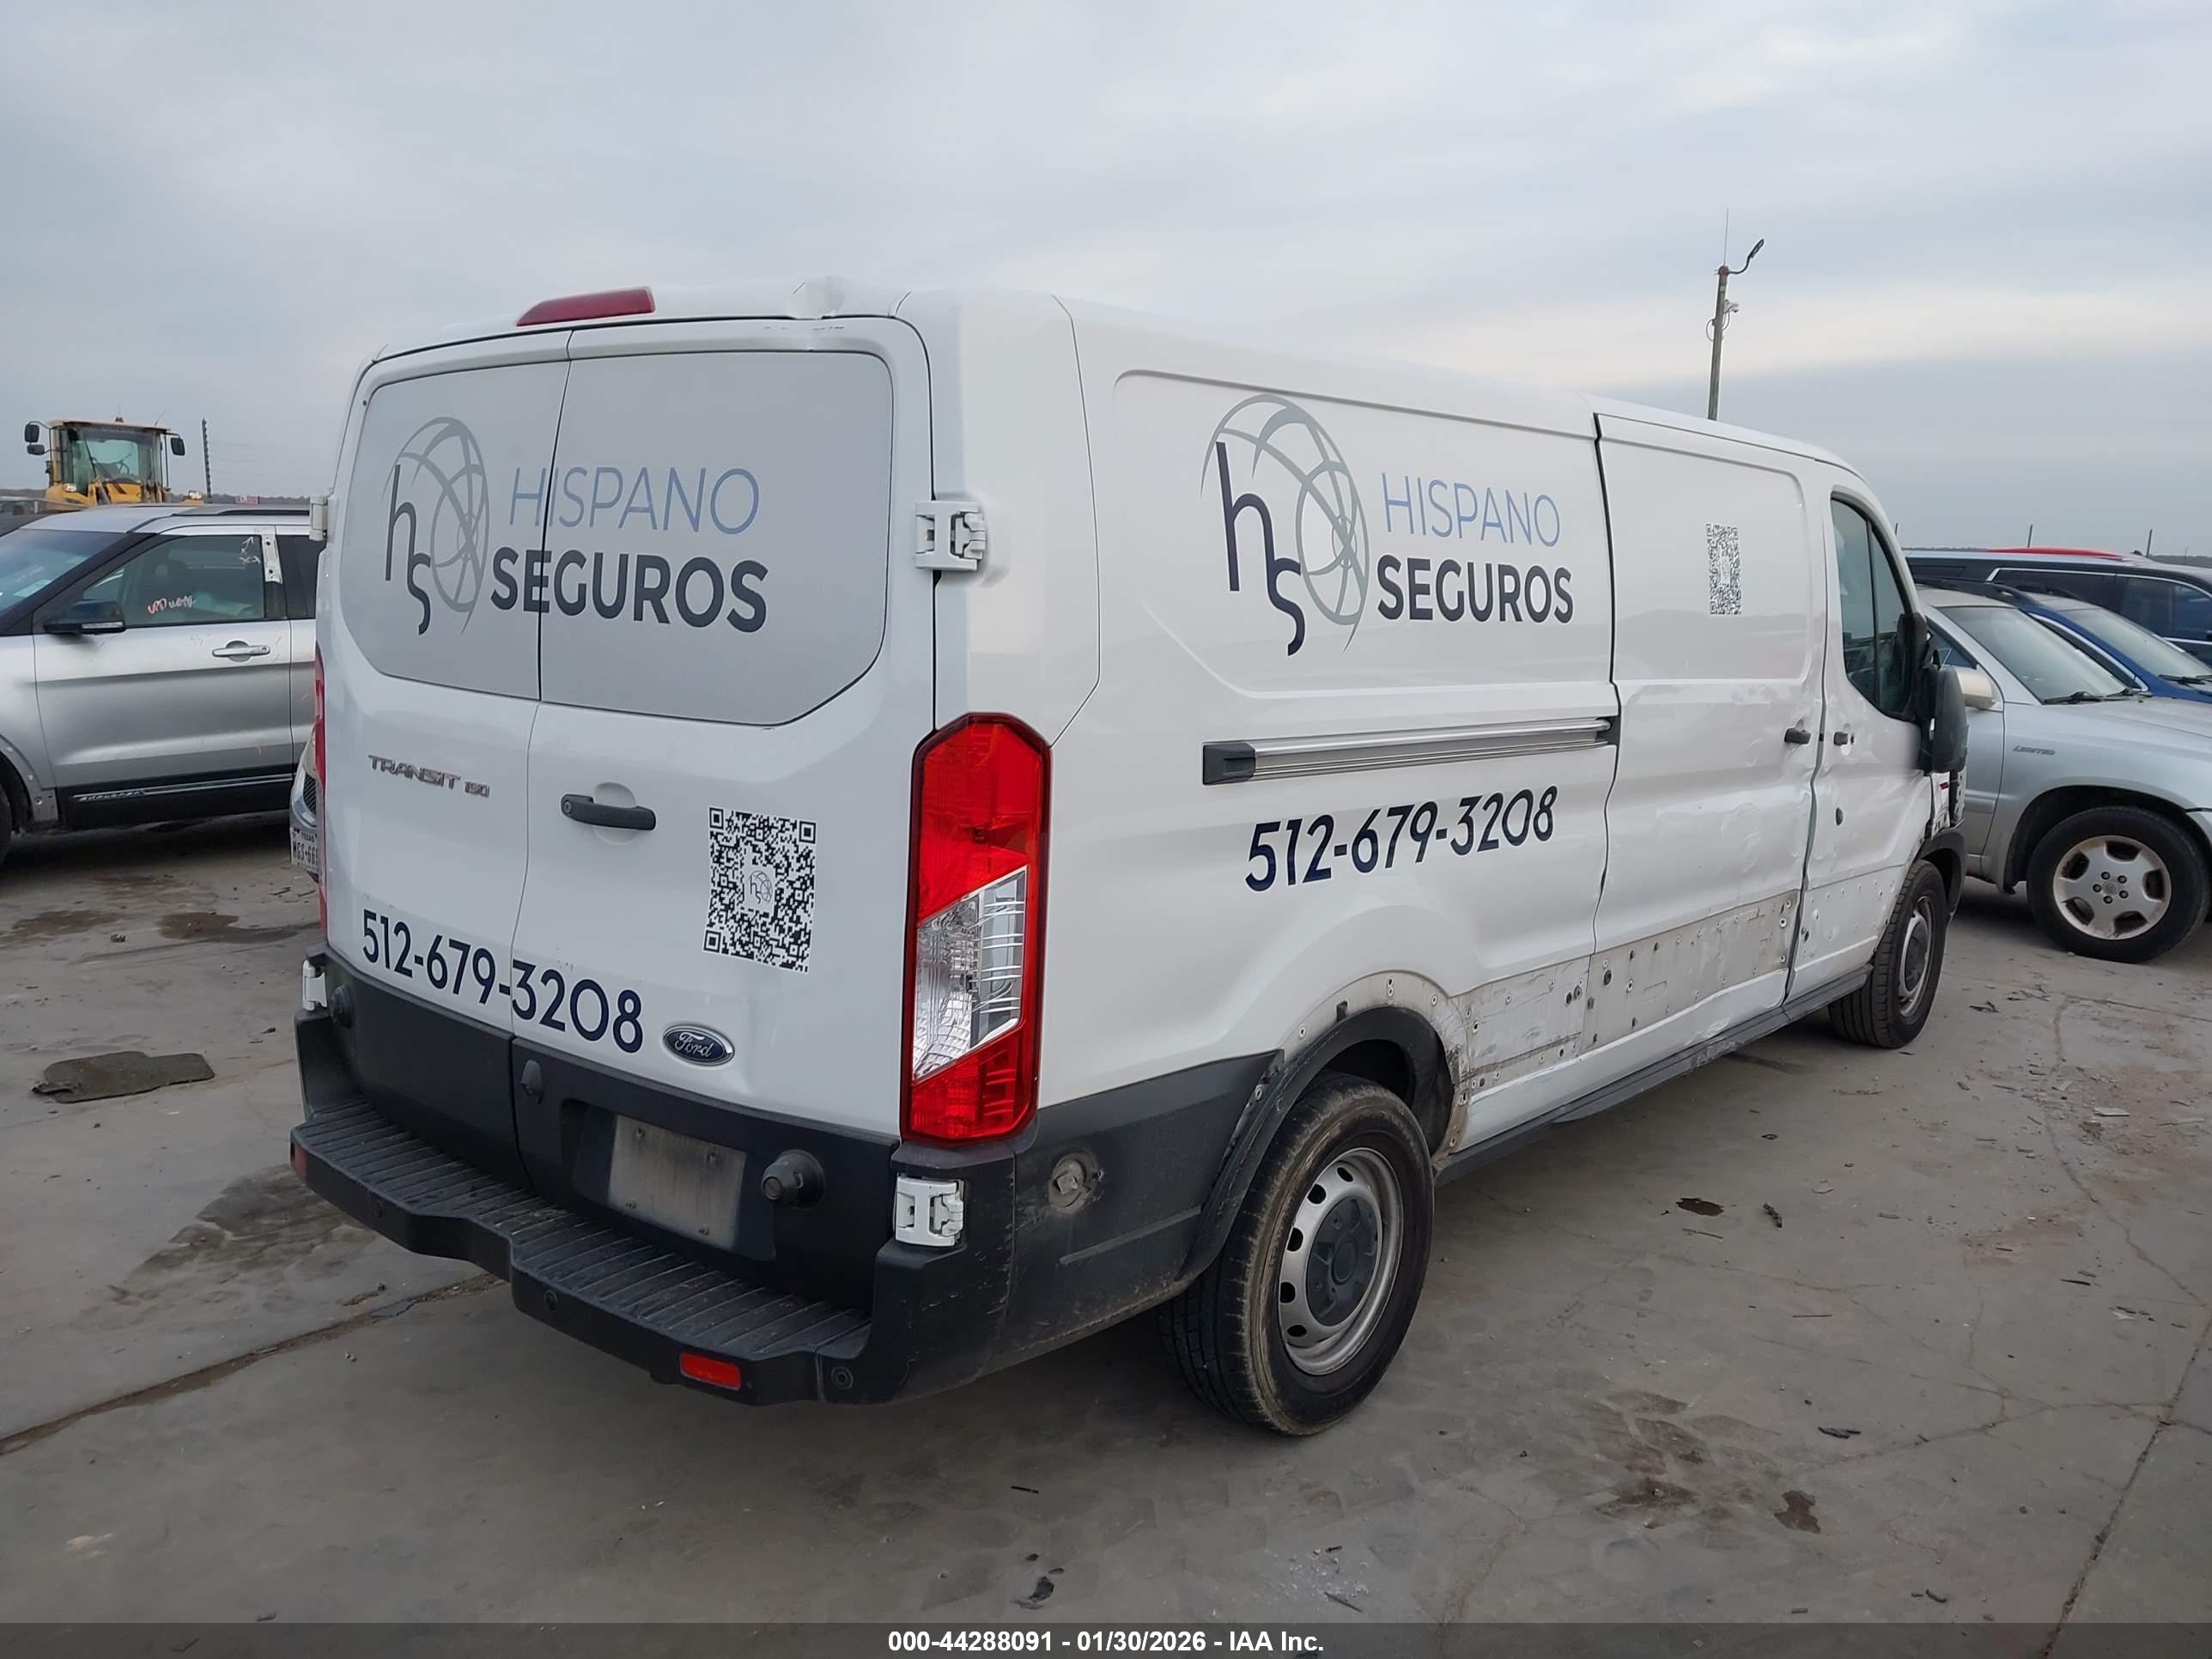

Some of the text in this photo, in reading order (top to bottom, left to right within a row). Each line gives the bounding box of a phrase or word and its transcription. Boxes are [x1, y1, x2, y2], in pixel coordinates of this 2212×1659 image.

[509, 466, 760, 535] HISPANO
[1381, 471, 1561, 547] HISPANO
[490, 546, 769, 633] SEGUROS
[1376, 554, 1574, 623] SEGUROS
[368, 755, 490, 798] TRANSIT 150
[1245, 785, 1558, 892] 512-679-3208
[362, 909, 644, 1054] 512-679-3208
[674, 1031, 714, 1057] Ford
